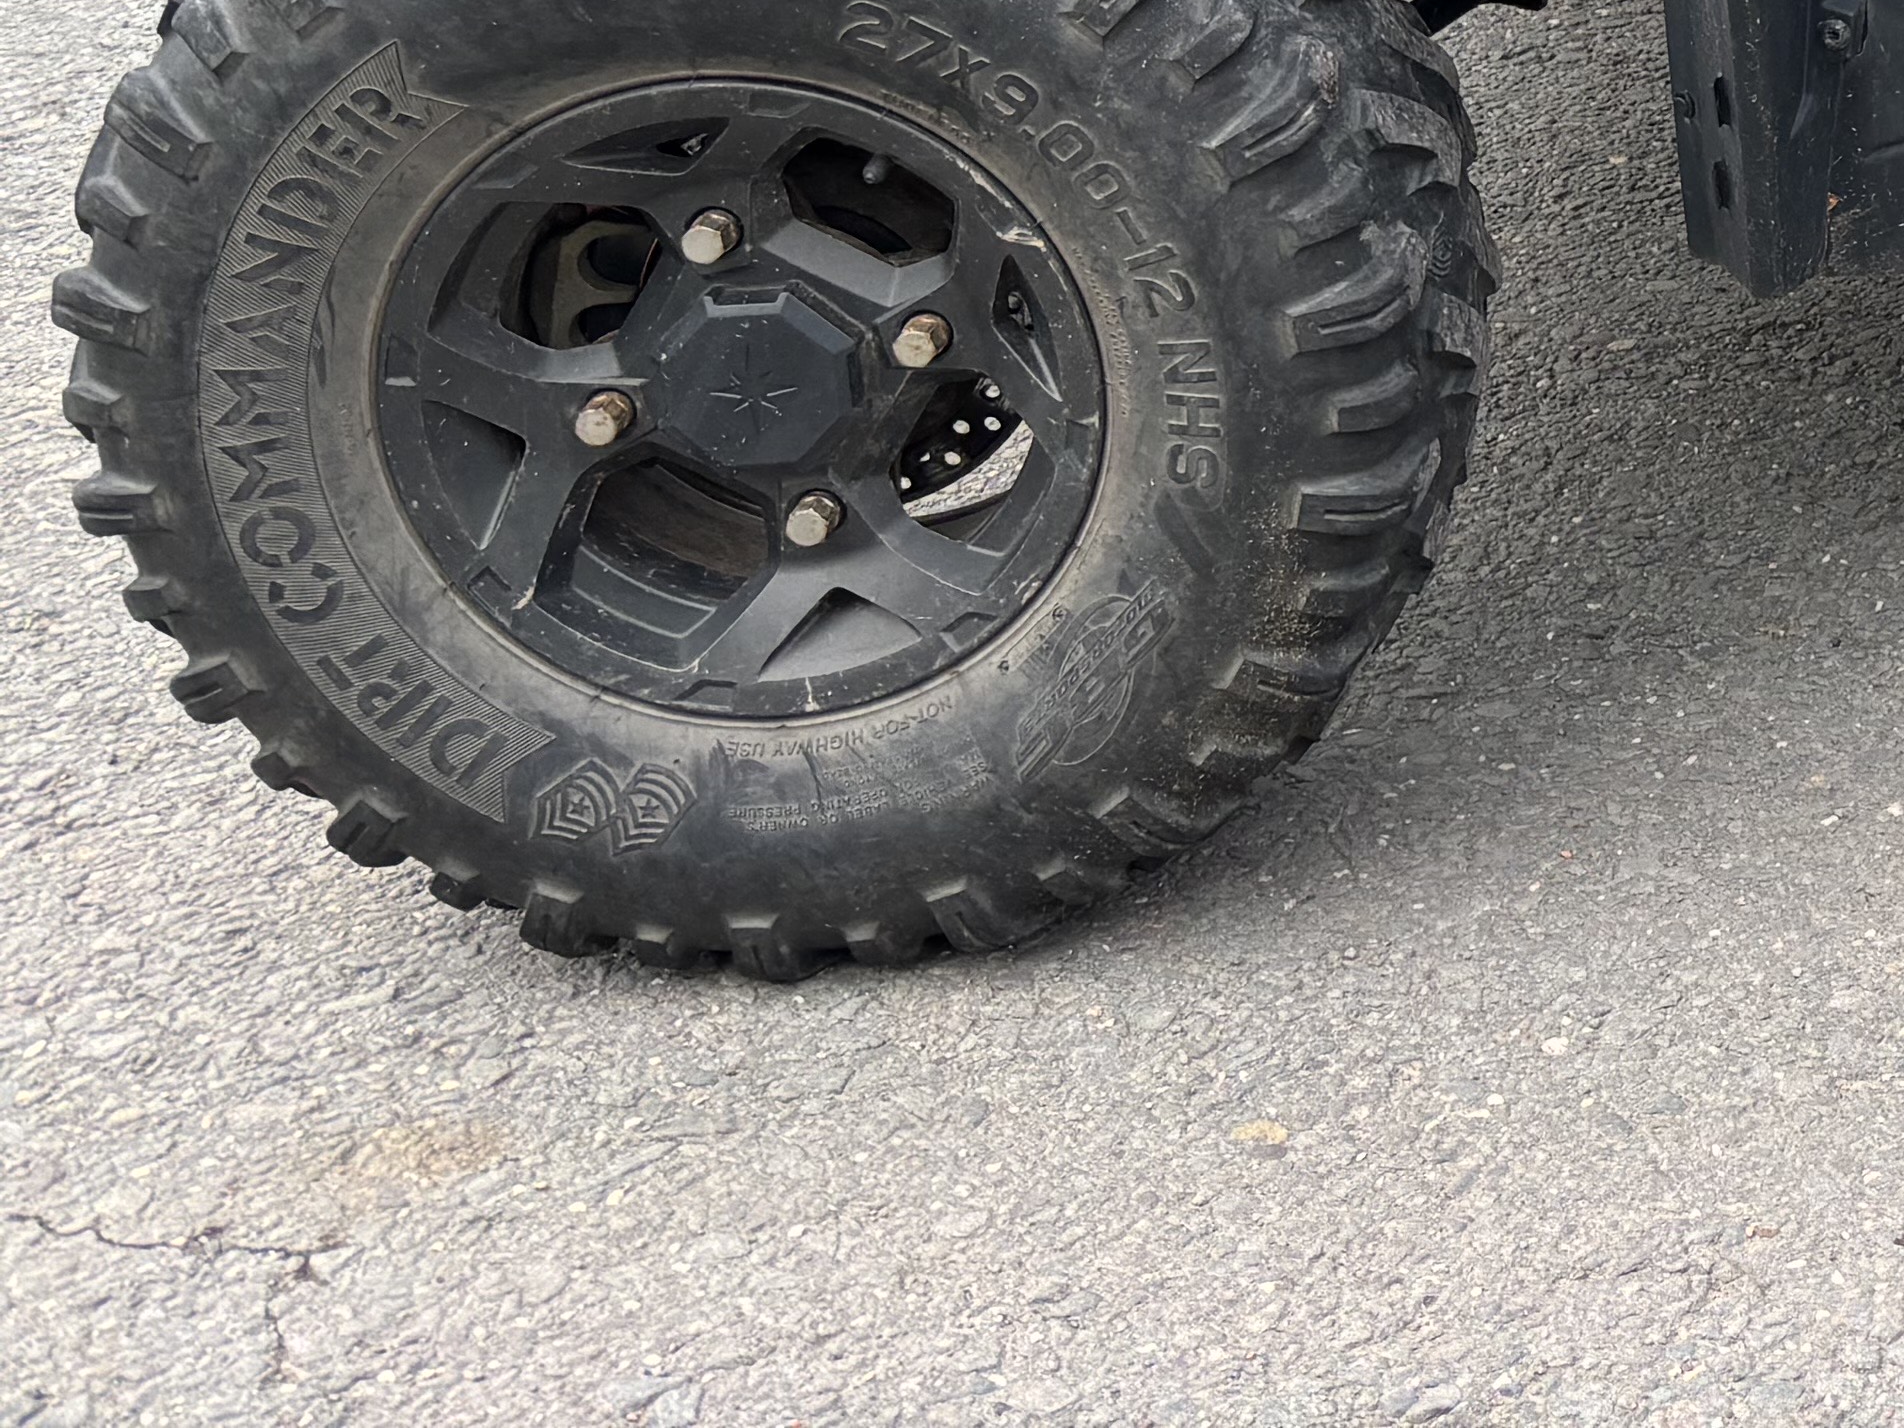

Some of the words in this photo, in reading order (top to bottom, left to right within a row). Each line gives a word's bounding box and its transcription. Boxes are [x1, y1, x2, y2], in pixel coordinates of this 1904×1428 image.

[209, 86, 427, 625] COMMANDER
[1158, 338, 1223, 490] NHS
[316, 632, 508, 788] DIRT
[726, 740, 765, 758] USE
[772, 727, 866, 758] HIGHWAY
